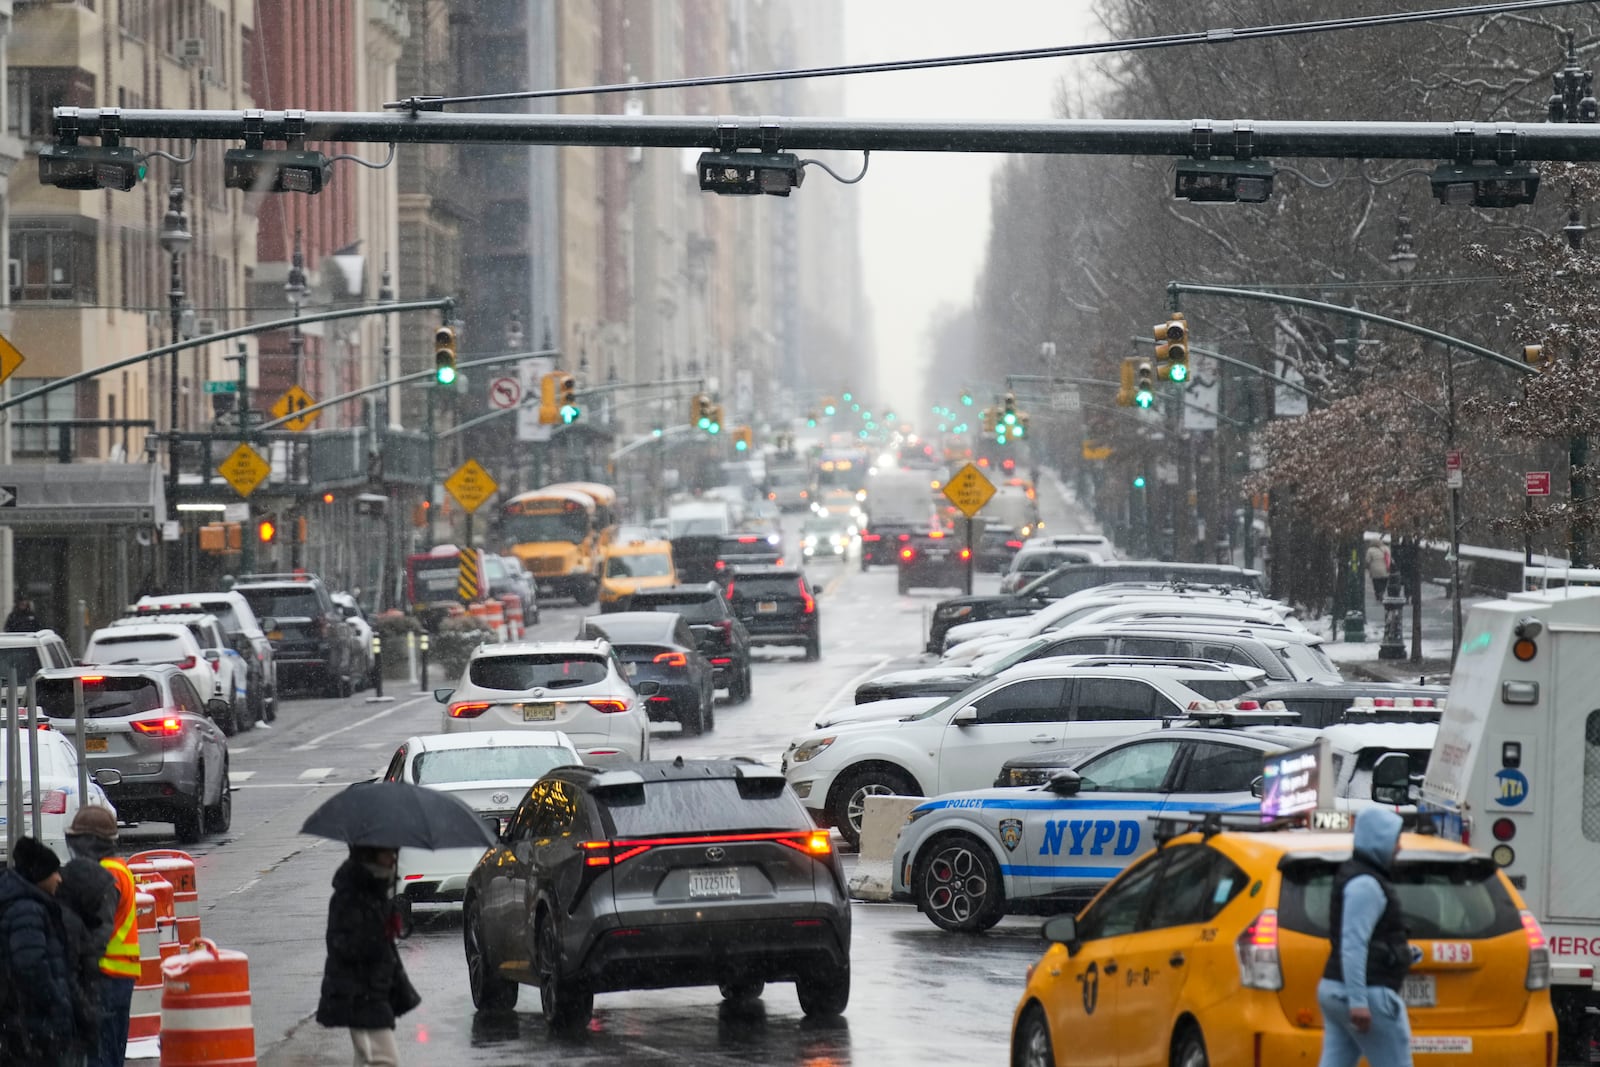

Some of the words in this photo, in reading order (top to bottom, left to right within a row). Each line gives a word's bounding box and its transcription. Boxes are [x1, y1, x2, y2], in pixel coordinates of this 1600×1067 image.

[947, 799, 984, 809] POLICE
[1314, 811, 1349, 829] 7V25
[1039, 820, 1141, 856] NYPD
[1436, 943, 1471, 962] 139
